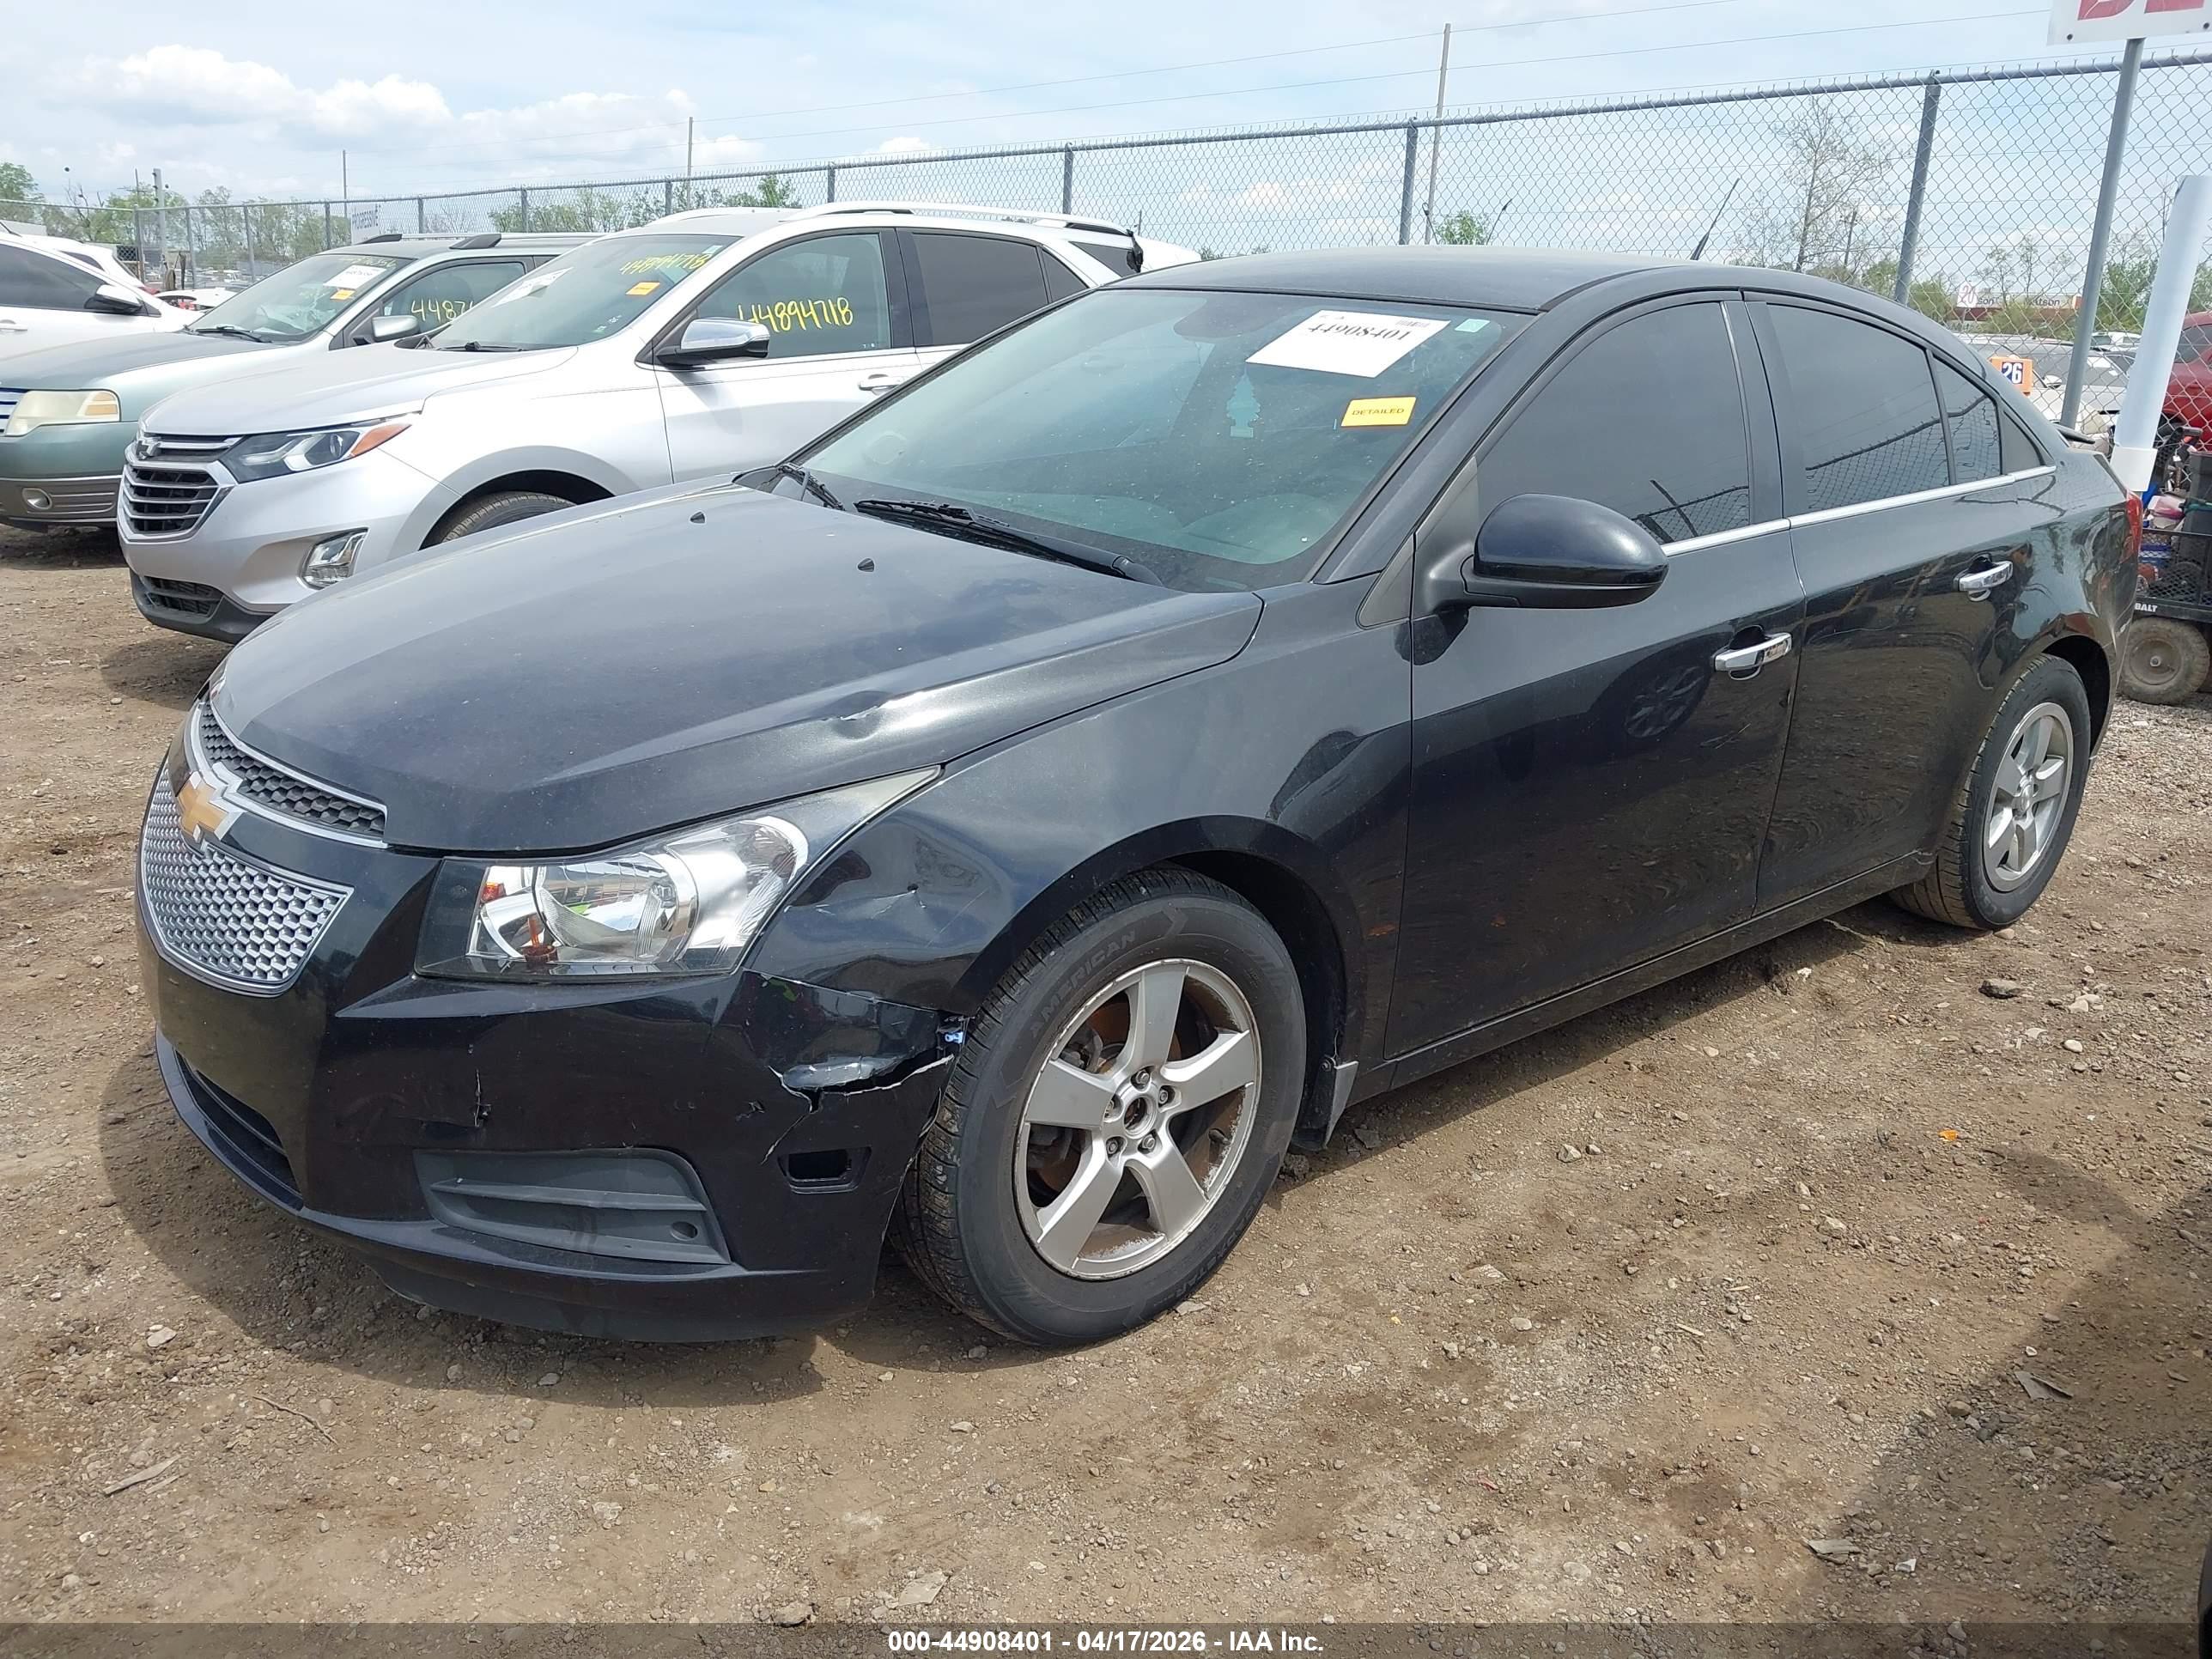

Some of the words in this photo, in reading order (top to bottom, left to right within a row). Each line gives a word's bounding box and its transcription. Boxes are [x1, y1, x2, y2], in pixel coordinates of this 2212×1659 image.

[410, 296, 473, 322] 4487
[738, 297, 853, 332] 44894718
[1308, 323, 1413, 341] 44908401
[2002, 362, 2022, 384] 26
